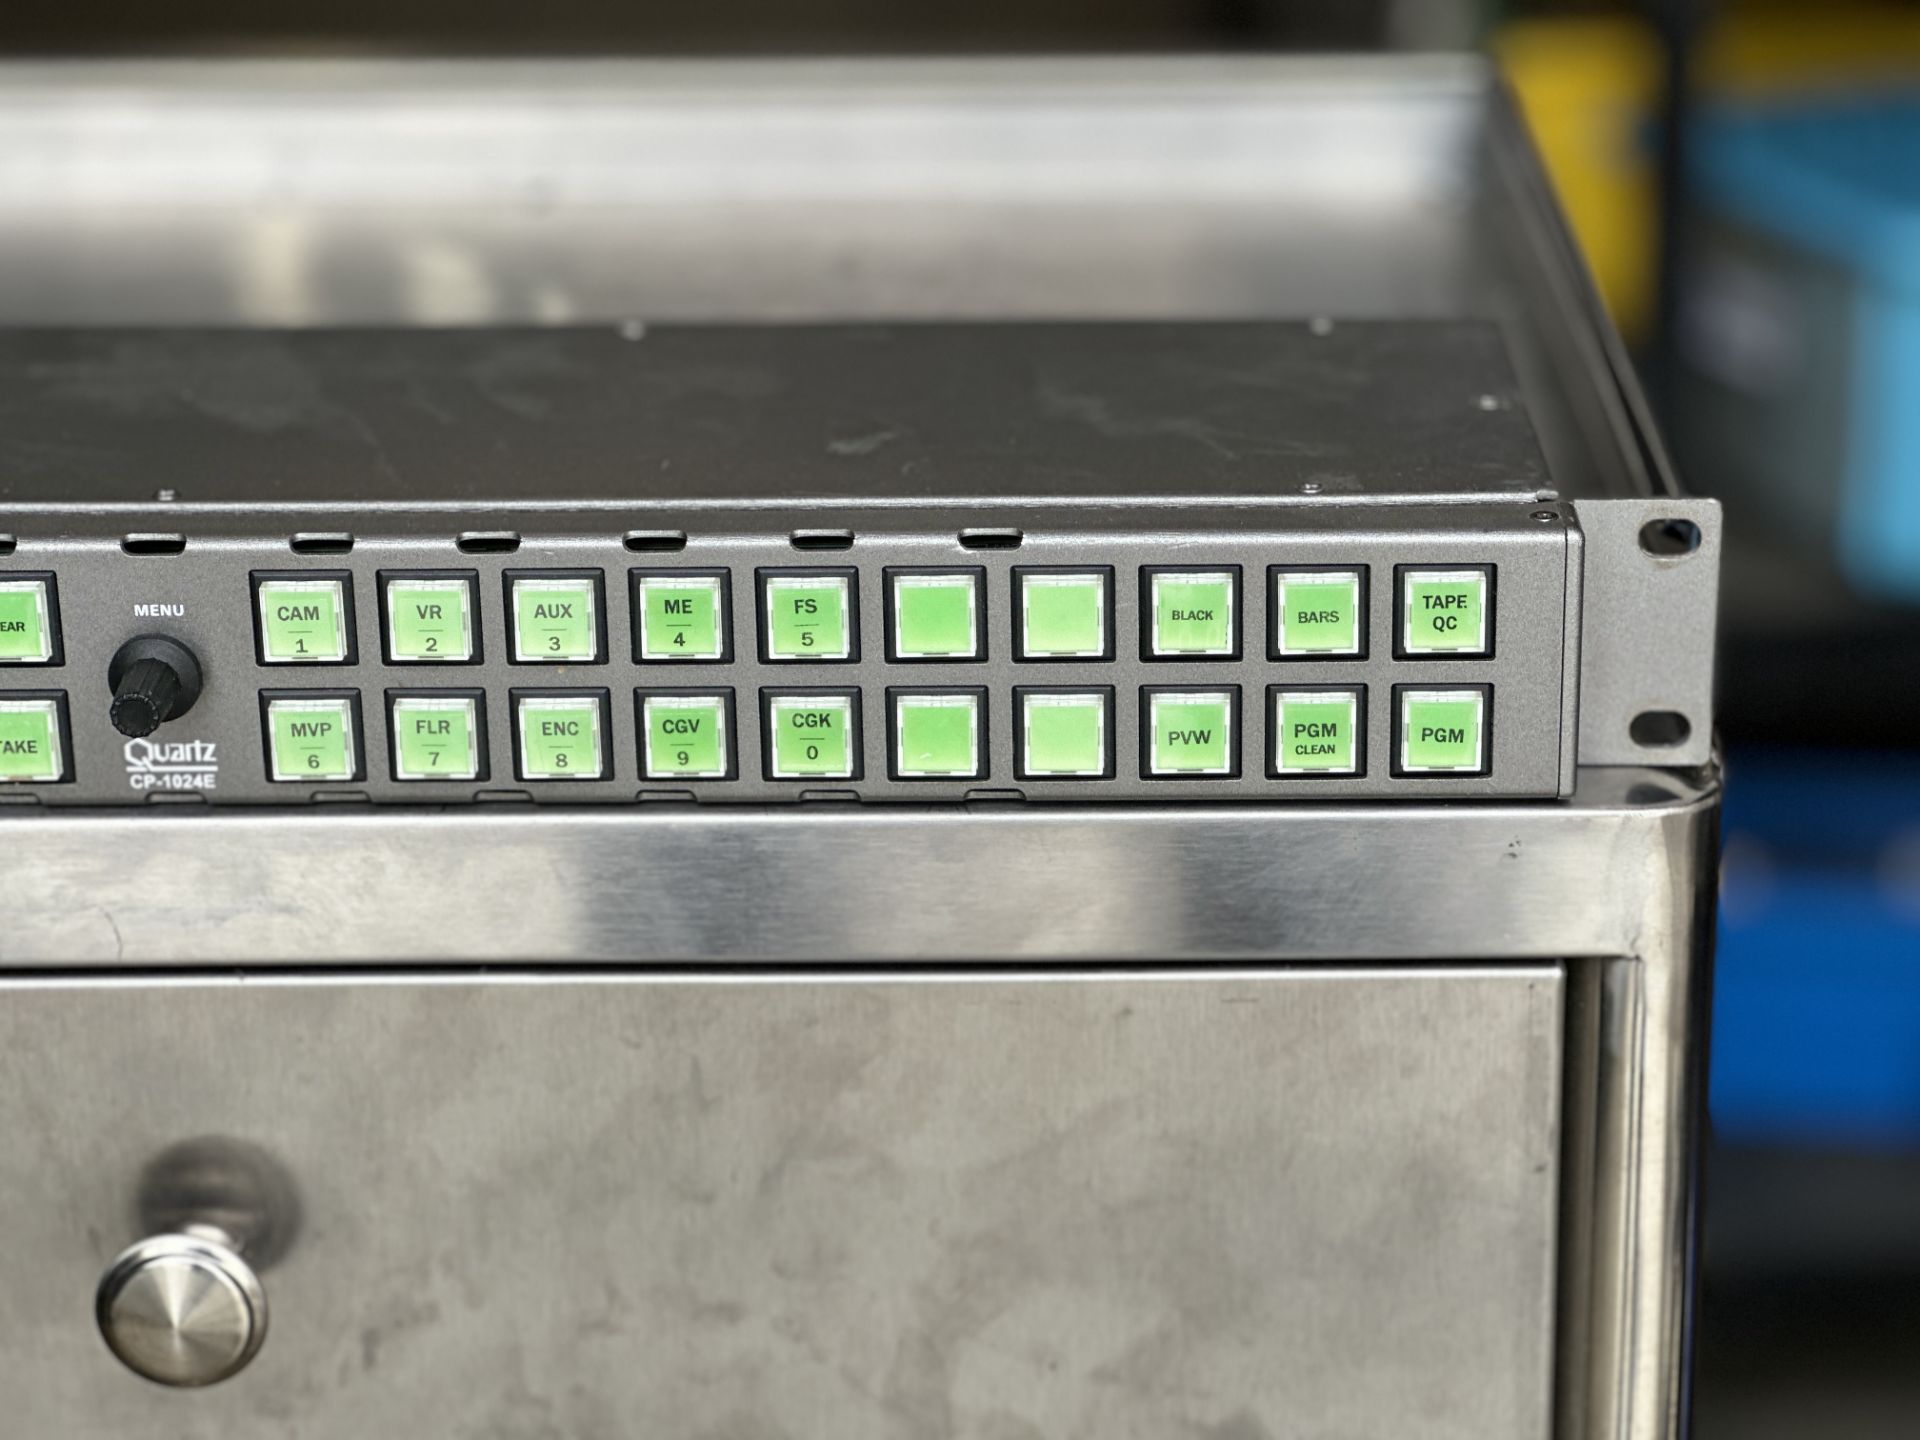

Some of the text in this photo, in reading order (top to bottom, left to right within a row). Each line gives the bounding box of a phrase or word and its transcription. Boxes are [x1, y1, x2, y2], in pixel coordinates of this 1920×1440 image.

[665, 600, 692, 613] ME
[795, 599, 817, 614] FS
[1423, 595, 1467, 609] TAPE
[134, 604, 185, 617] MENU
[278, 606, 319, 621] CAM
[417, 605, 441, 619] VR
[535, 604, 572, 618] AUX
[1172, 610, 1213, 620] BLACK
[1298, 611, 1339, 623] BARS
[0, 622, 24, 631] EAR
[1433, 616, 1457, 632] QC
[296, 639, 308, 653] 1
[426, 638, 437, 651] 2
[549, 637, 560, 651] 3
[674, 633, 685, 646] 4
[802, 632, 813, 646] 5
[417, 720, 449, 734] FLR
[663, 719, 699, 734] CGV
[793, 714, 830, 727] CGK
[291, 723, 331, 737] MVP
[542, 722, 578, 735] ENC
[1295, 723, 1336, 737] PGM
[1422, 728, 1464, 743] PGM
[1169, 730, 1211, 745] PVW
[0, 741, 37, 753] AKE
[124, 737, 217, 769] Quartz
[807, 746, 818, 759] 0
[1296, 745, 1335, 755] CLEAN
[308, 755, 319, 768] 6
[429, 752, 439, 765] 7
[556, 754, 567, 767] 8
[677, 751, 689, 765] 9
[130, 774, 216, 789] CP-1024E
